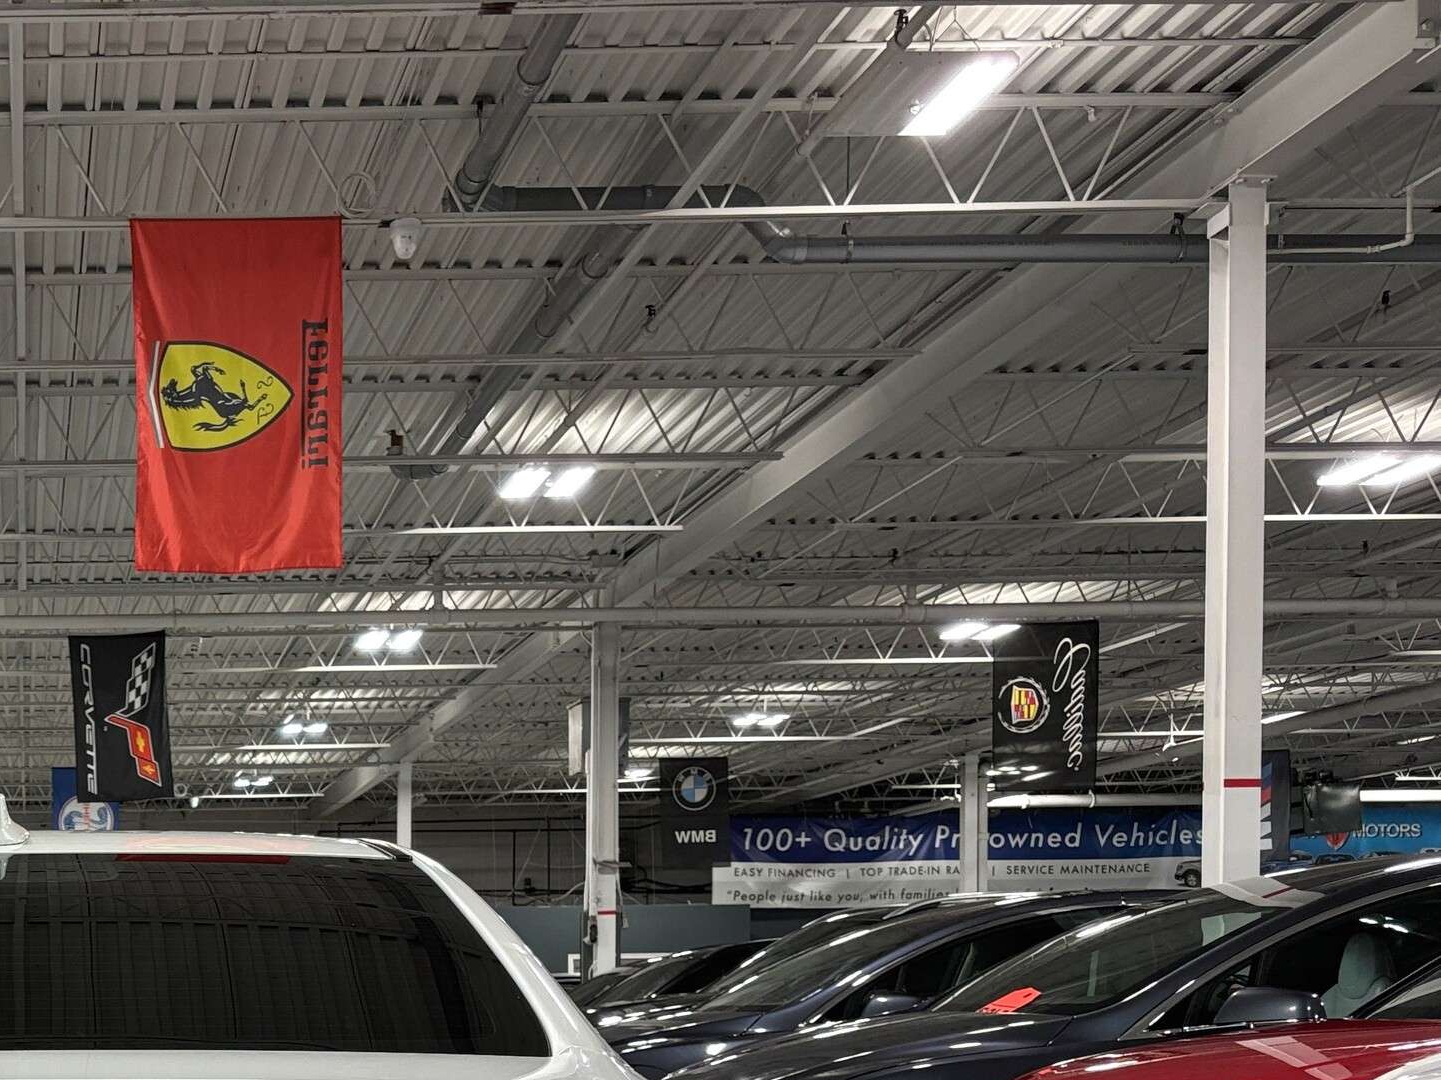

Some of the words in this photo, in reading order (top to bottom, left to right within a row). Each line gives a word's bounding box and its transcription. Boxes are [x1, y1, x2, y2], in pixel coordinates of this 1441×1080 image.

[80, 643, 98, 796] CORVETTE
[743, 828, 812, 852] 100+
[823, 825, 924, 855] Quality
[1095, 819, 1203, 847] Vehicles
[734, 867, 763, 877] EASY
[767, 867, 836, 879] FINANCING
[860, 867, 883, 877] TOP
[888, 865, 941, 877] TRADE-IN
[1006, 865, 1055, 876] SERVICE
[1060, 863, 1151, 875] MAINTENANCE
[781, 890, 806, 904] just
[808, 890, 835, 903] like
[837, 893, 863, 904] you,
[869, 889, 895, 901] with
